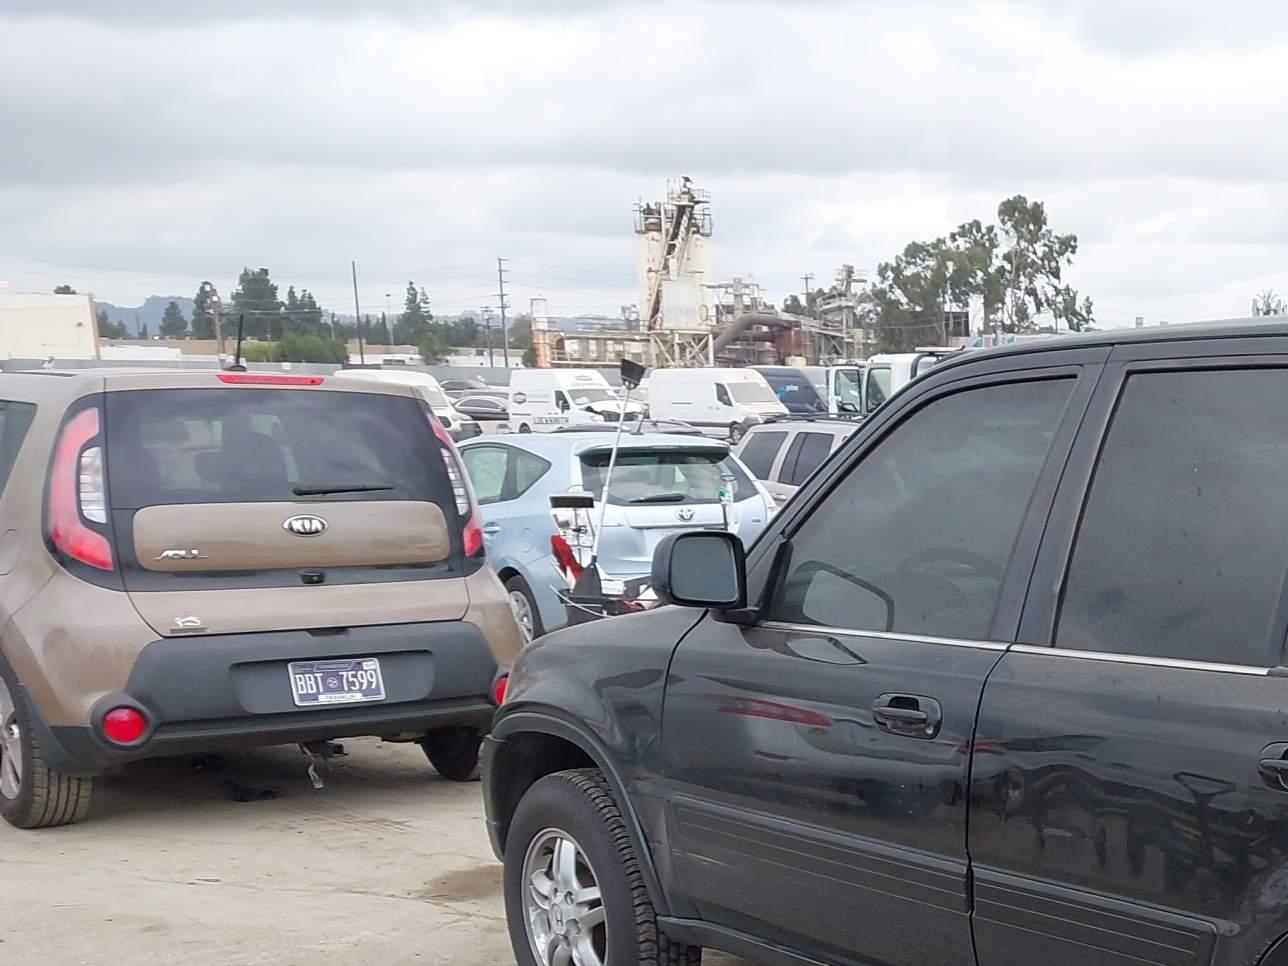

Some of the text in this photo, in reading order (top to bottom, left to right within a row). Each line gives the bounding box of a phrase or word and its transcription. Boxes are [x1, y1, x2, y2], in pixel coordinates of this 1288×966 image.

[291, 519, 322, 533] KIA
[295, 670, 377, 694] BBT 7599
